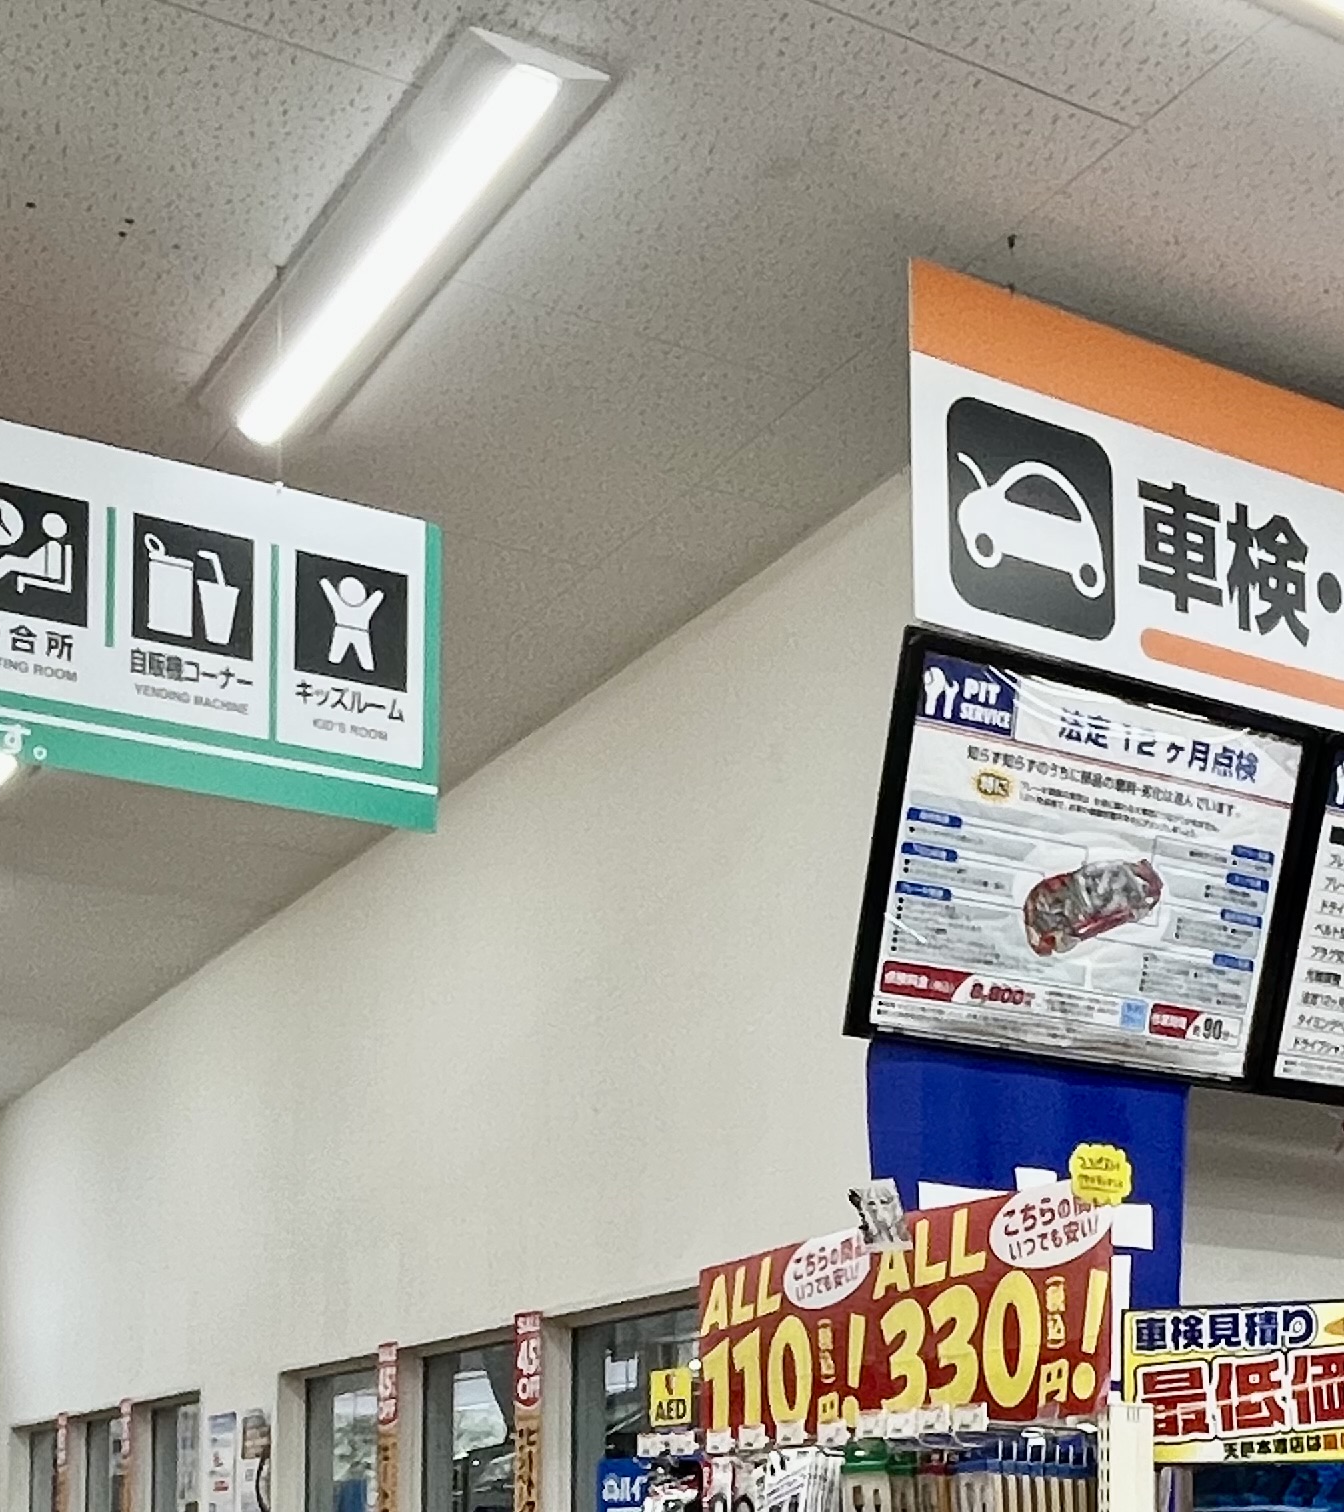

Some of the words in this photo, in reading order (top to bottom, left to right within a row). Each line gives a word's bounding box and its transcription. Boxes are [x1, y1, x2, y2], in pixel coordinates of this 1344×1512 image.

[33, 664, 77, 682] ROOM
[130, 647, 254, 689] 自販機コーナー
[295, 681, 405, 722] キッズルーム
[962, 678, 1001, 705] PIT
[958, 701, 1011, 729] SERVICE
[872, 1208, 986, 1300] ALL
[699, 1256, 783, 1336] ALL
[1134, 1309, 1316, 1354] 車検見積り
[655, 1398, 687, 1422] AED
